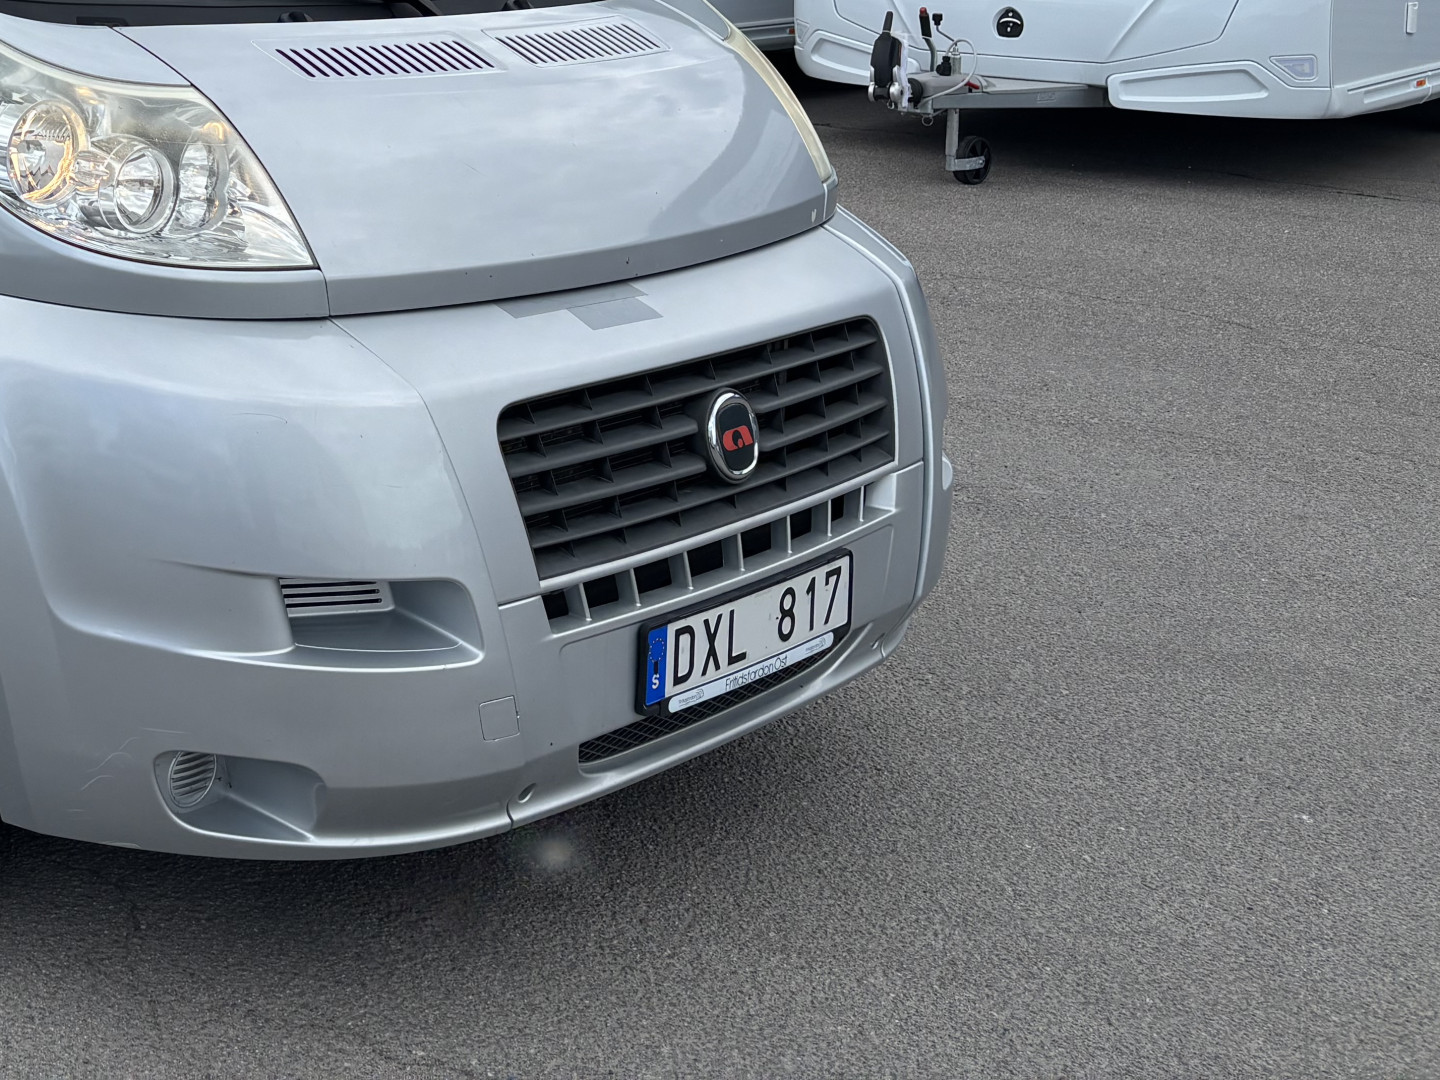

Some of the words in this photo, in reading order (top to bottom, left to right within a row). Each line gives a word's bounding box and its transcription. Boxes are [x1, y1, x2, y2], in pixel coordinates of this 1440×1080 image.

[673, 608, 748, 687] DXL
[777, 565, 842, 643] 817
[651, 673, 660, 690] S
